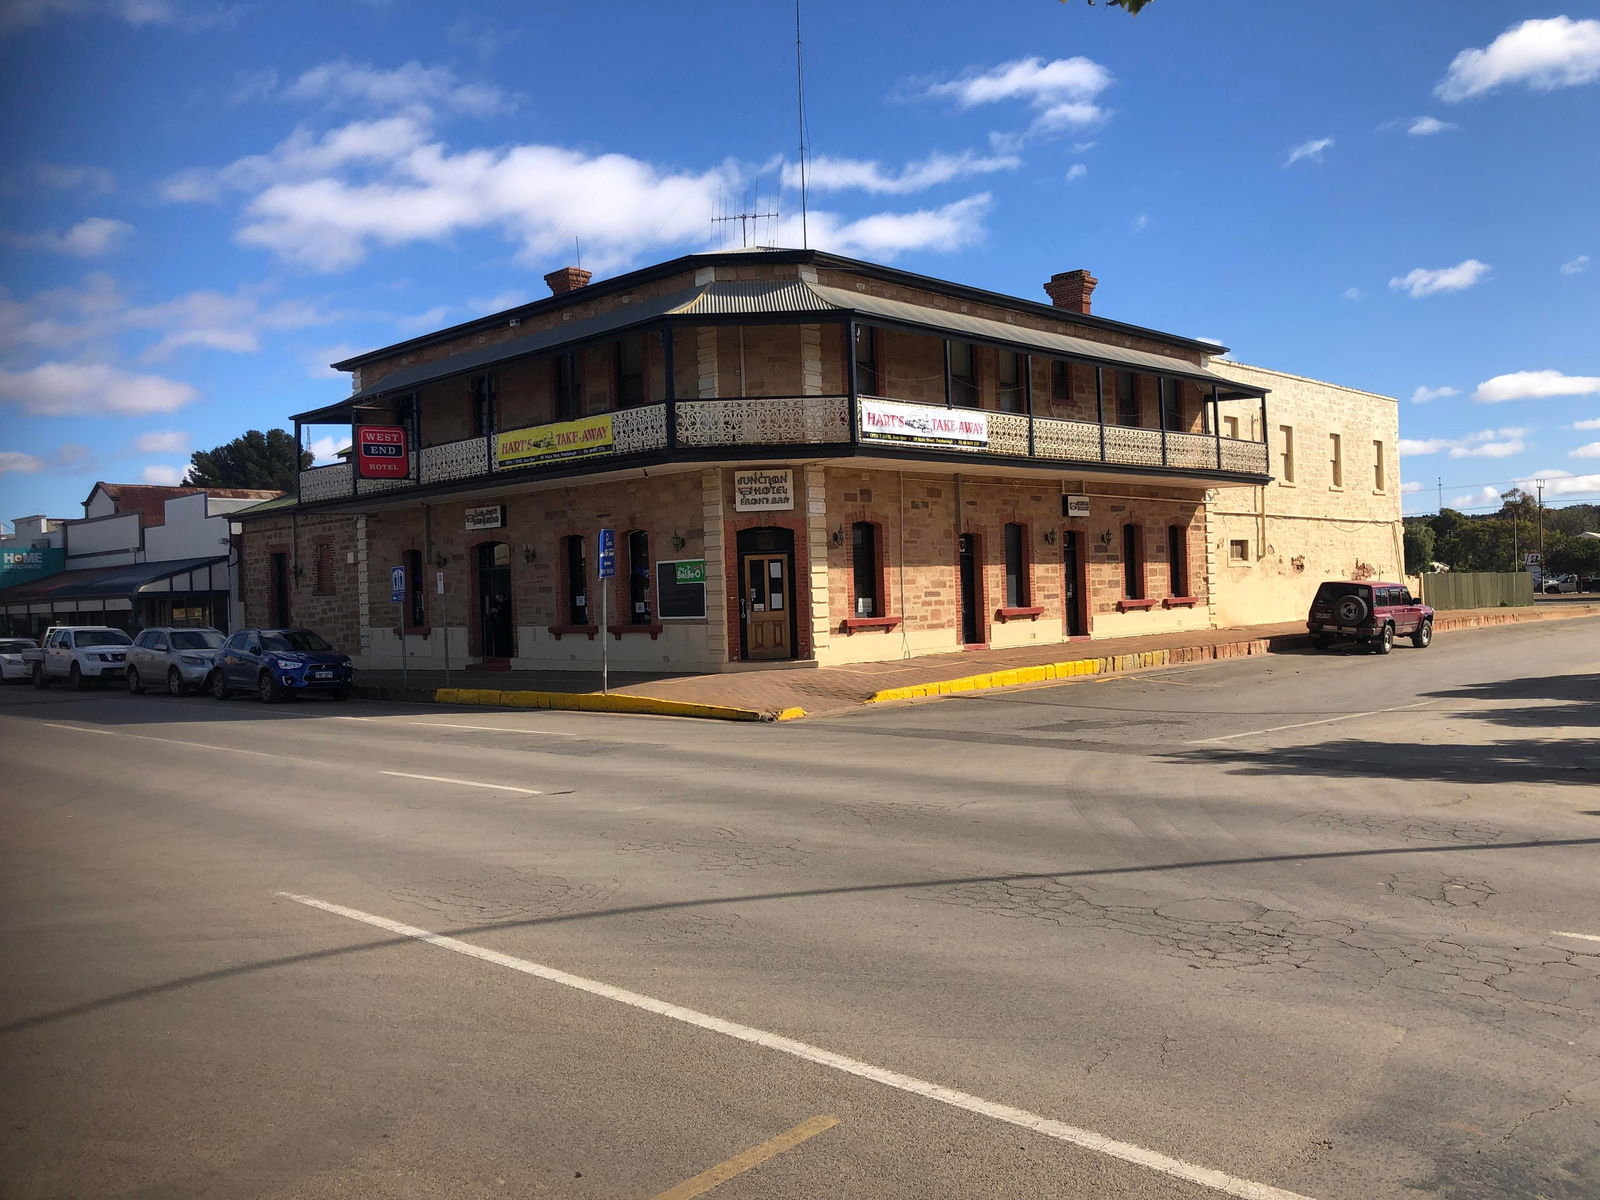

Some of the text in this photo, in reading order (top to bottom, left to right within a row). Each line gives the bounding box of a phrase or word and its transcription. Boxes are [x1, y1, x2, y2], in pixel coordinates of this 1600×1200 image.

[867, 412, 984, 435] HART'S TAKE-AWAY
[365, 433, 399, 441] WEST
[502, 438, 533, 455] HART'S
[556, 425, 609, 446] TAKE-AWAY
[370, 446, 396, 454] END
[737, 472, 788, 485] JUNCTION
[754, 485, 788, 495] HOTEL
[3, 552, 43, 564] HOME
